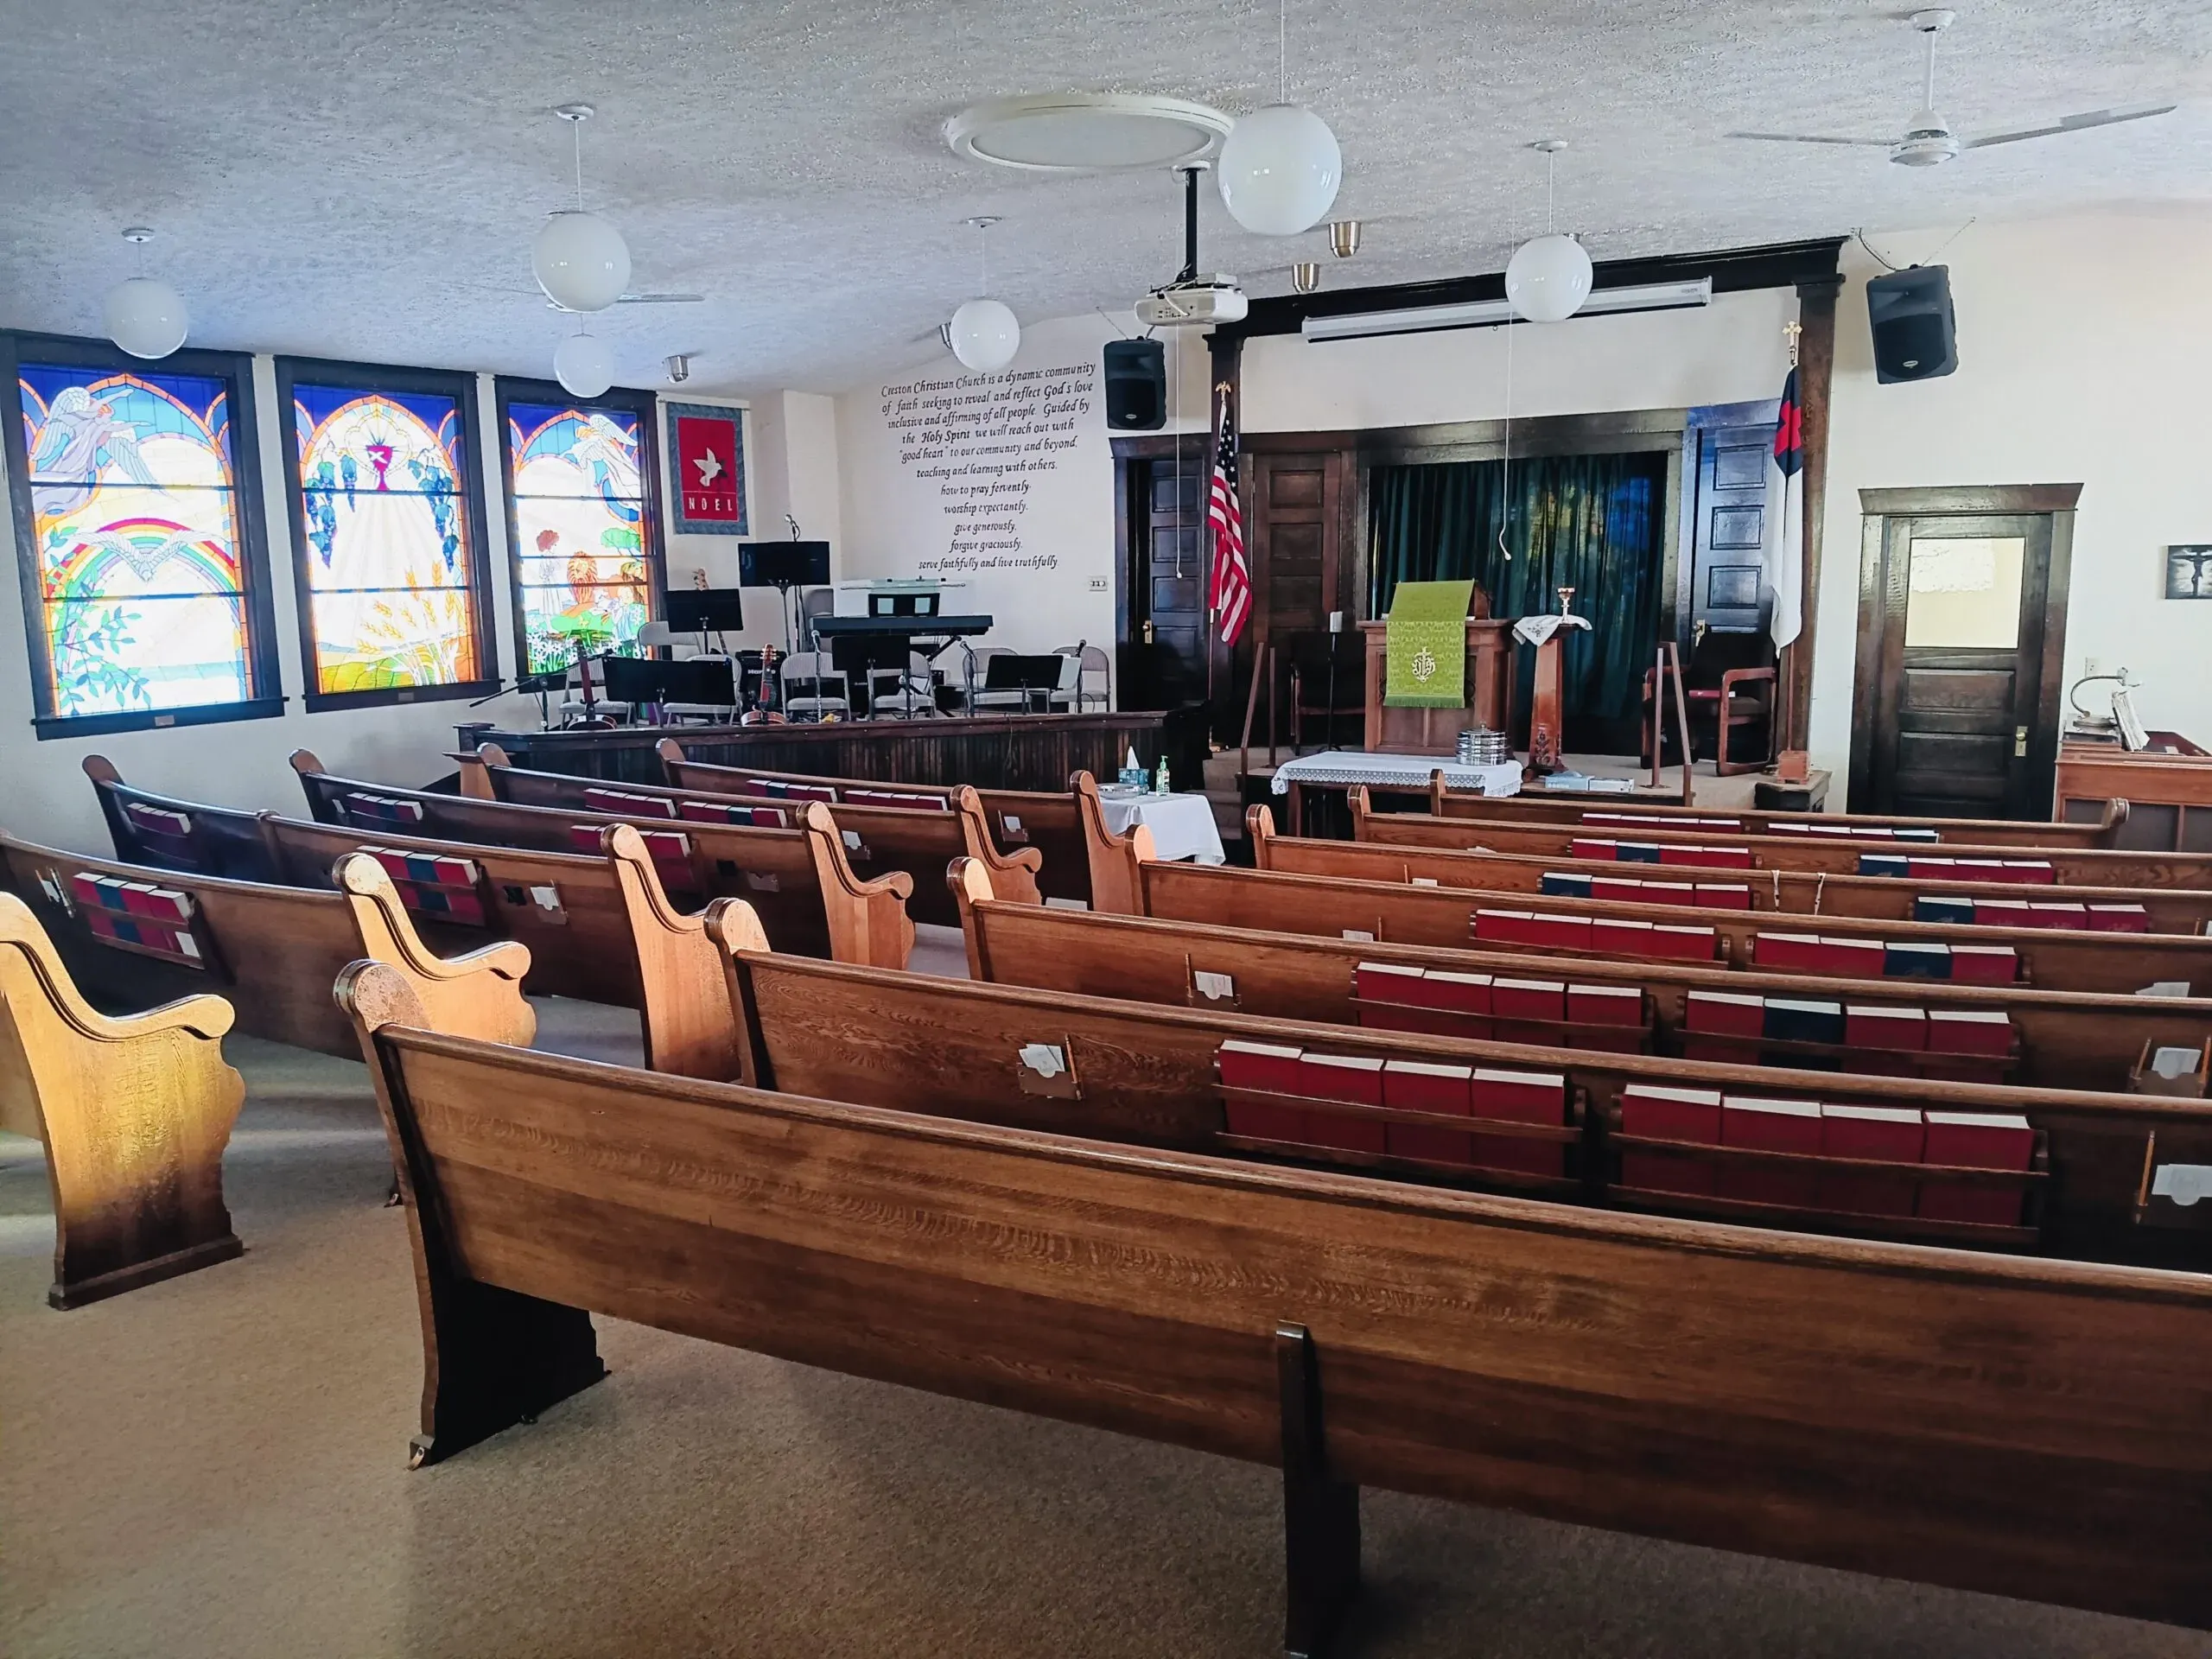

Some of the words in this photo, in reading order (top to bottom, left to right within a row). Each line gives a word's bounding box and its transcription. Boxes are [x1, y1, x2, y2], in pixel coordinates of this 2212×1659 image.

[881, 385, 912, 397] Creston
[913, 380, 954, 394] Christian
[956, 375, 986, 390] Church
[988, 374, 995, 385] is
[1005, 369, 1043, 386] dynamic
[1045, 361, 1096, 378] community
[881, 400, 893, 416] of
[895, 397, 918, 416] faith
[921, 395, 952, 410] seeking
[953, 397, 963, 405] to
[964, 391, 991, 404] reveal
[994, 388, 1013, 402] and
[1013, 385, 1040, 403] reflect
[1044, 381, 1072, 400] God's
[1074, 379, 1093, 393] love
[888, 416, 923, 429] inclusive
[924, 412, 942, 425] and
[942, 410, 981, 427] affirming
[982, 407, 994, 423] of
[994, 406, 1007, 419] all
[1043, 398, 1079, 418] Guided
[1079, 397, 1090, 415] by
[902, 432, 916, 444] the
[921, 429, 943, 445] Holy
[944, 429, 970, 444] Spirit
[989, 423, 1008, 436] will
[1008, 421, 1032, 435] reach
[1034, 423, 1049, 434] out
[1052, 417, 1074, 431] with
[950, 448, 959, 457] to
[961, 448, 976, 456] our
[976, 443, 1021, 456] community
[1024, 438, 1044, 451] and
[917, 466, 950, 480] teaching
[952, 463, 969, 475] and
[969, 463, 1003, 477] learning
[1005, 459, 1027, 472] with
[940, 484, 958, 495] how
[960, 486, 969, 494] to
[969, 486, 989, 498] pray
[689, 497, 733, 512] NOEL
[944, 502, 977, 516] worship
[953, 524, 971, 536] give
[949, 538, 978, 554] forgive
[918, 561, 938, 569] serve
[938, 556, 979, 572] faithfully
[980, 556, 997, 568] and
[998, 556, 1014, 567] live
